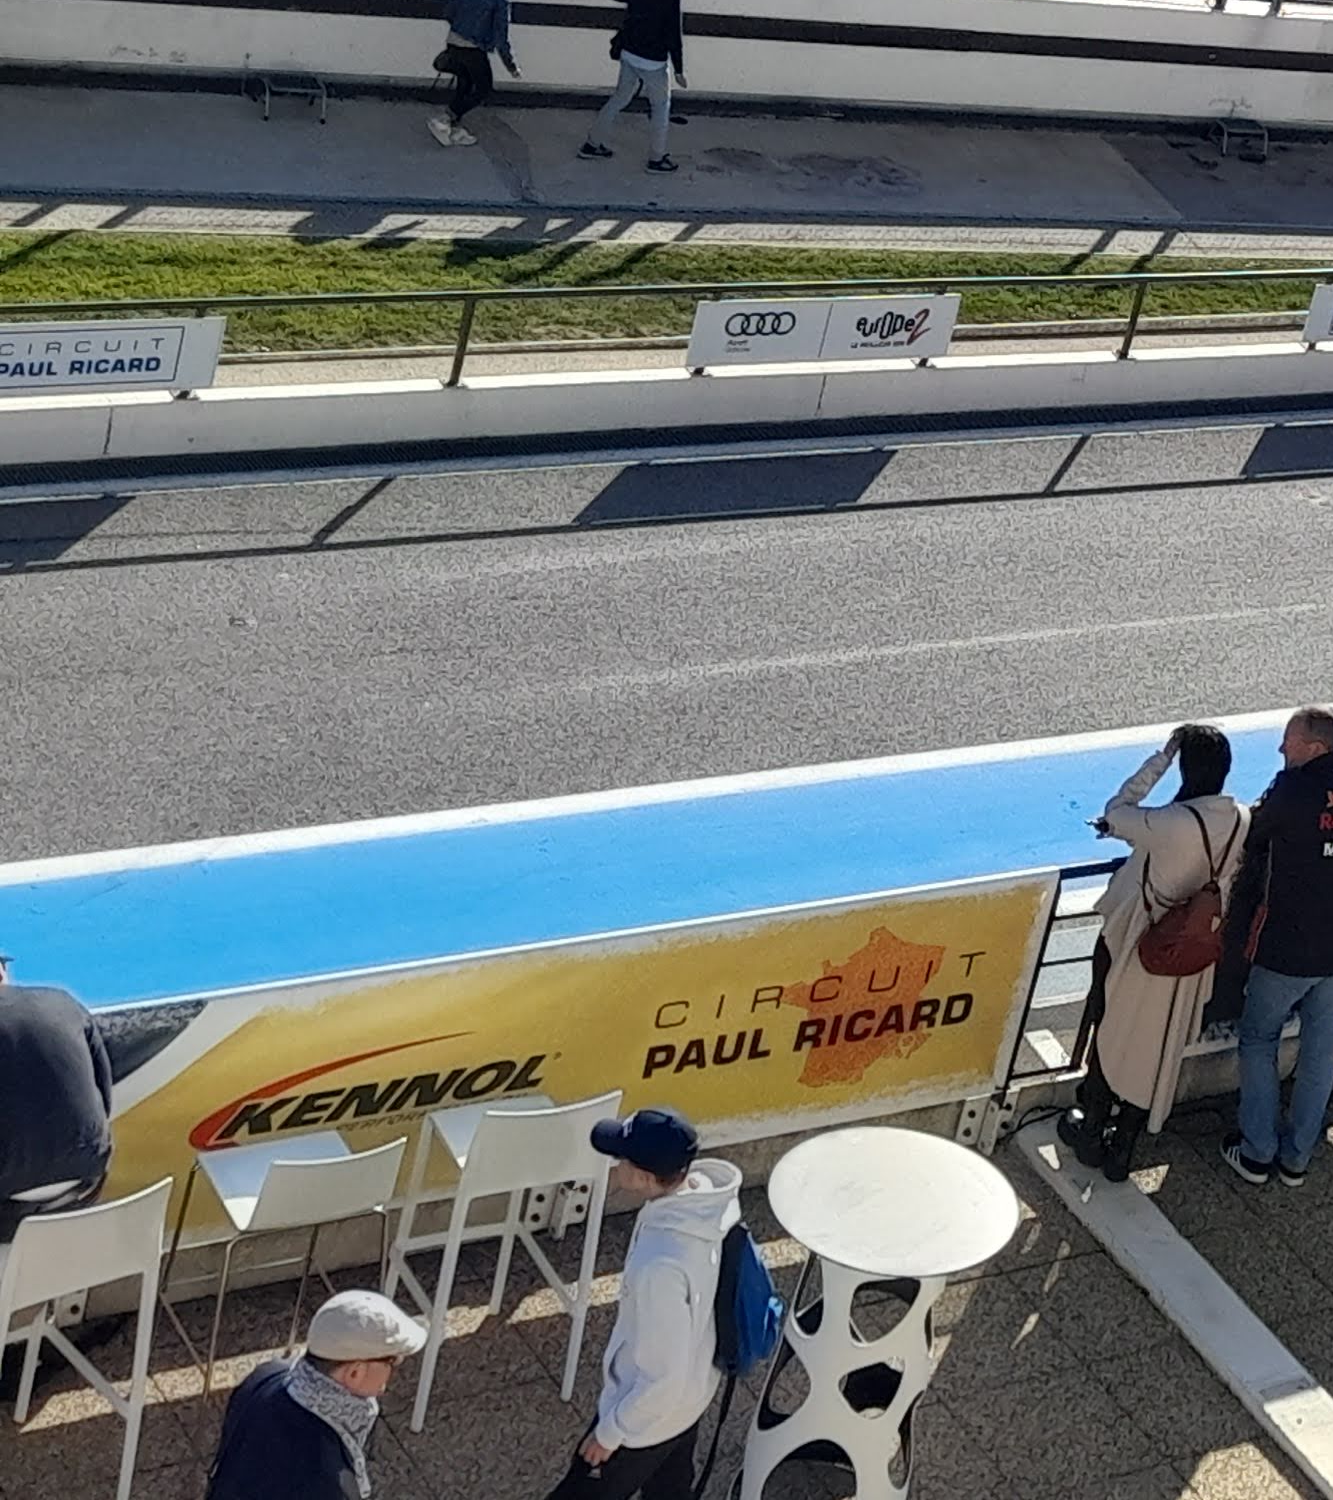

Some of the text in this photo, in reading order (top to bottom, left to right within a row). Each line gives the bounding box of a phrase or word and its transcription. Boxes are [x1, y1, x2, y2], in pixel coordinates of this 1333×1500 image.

[0, 337, 166, 357] CIRCUIT
[68, 357, 162, 376] RICARD
[655, 952, 986, 1029] CIRCUIT
[642, 993, 974, 1079] PAUL RICARD
[215, 1054, 546, 1141] KENNOL
